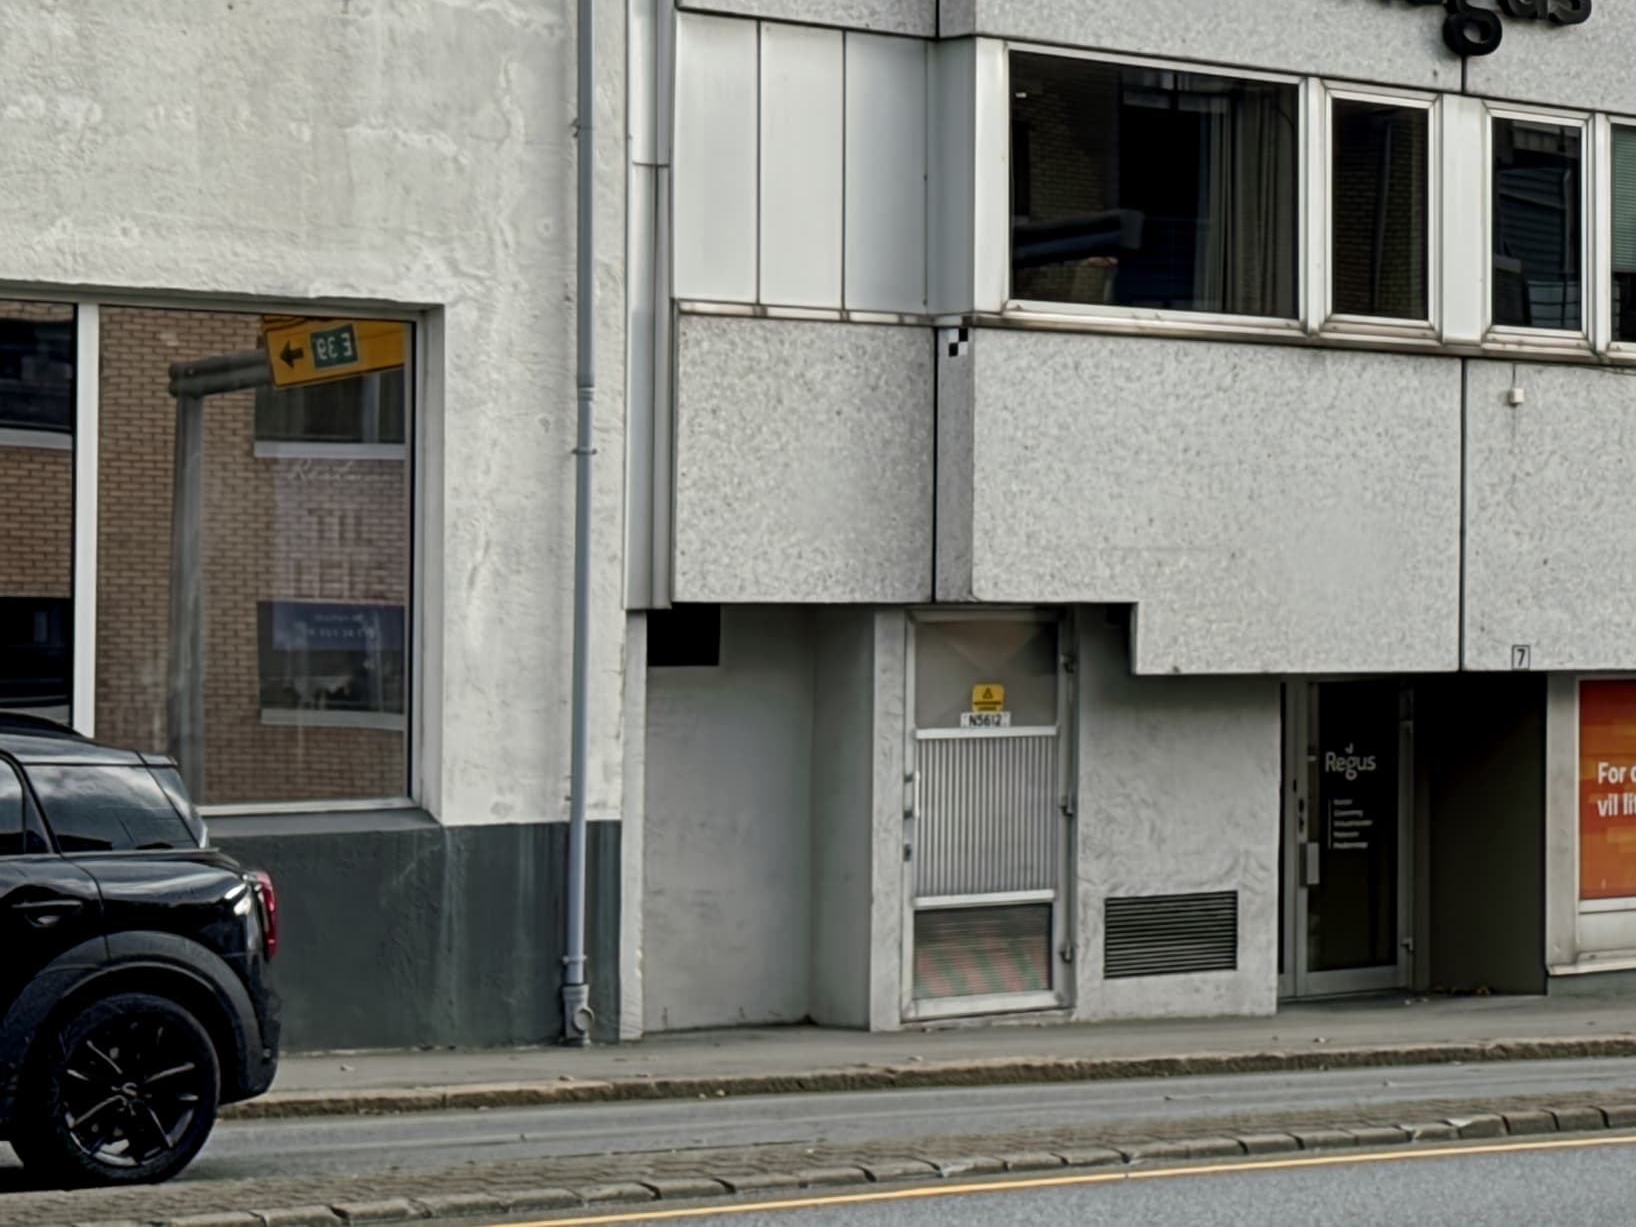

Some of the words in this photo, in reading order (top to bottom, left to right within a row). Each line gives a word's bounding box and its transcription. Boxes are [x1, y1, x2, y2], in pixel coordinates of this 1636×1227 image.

[1516, 648, 1526, 667] 7
[1325, 751, 1377, 781] Regus
[1598, 761, 1627, 785] For
[1597, 792, 1619, 817] vil
